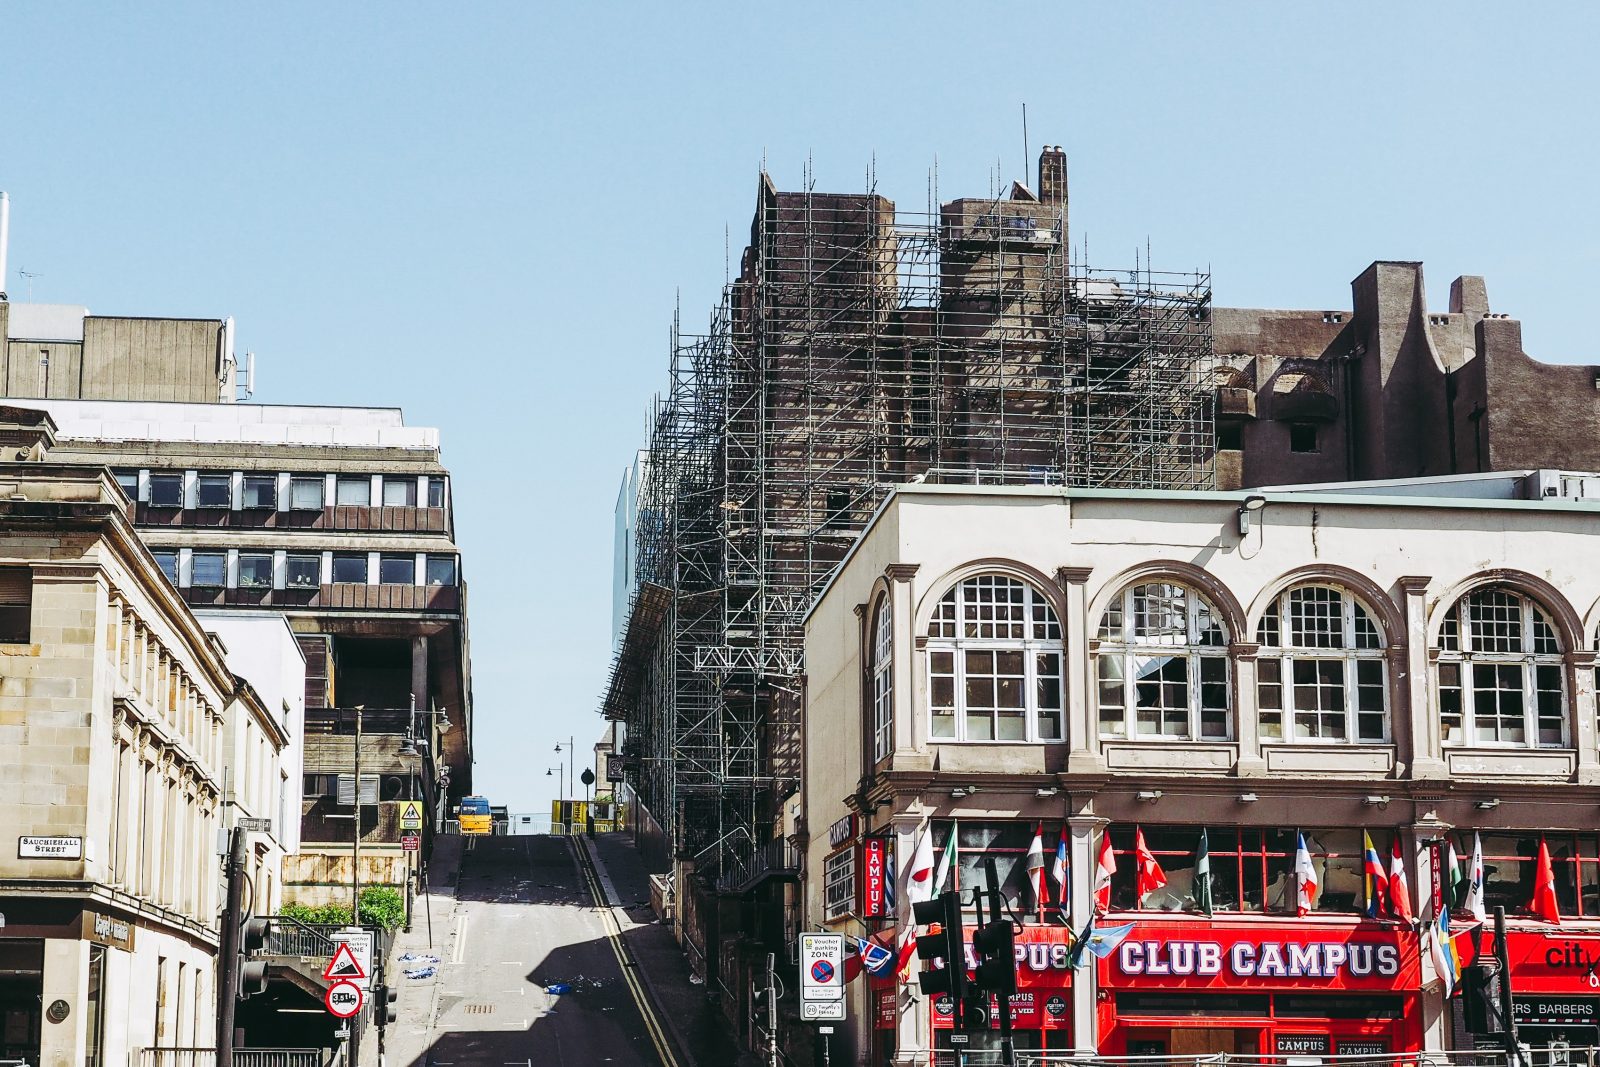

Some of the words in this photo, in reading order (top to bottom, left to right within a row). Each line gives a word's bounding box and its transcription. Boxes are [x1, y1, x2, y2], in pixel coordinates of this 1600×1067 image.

[23, 838, 78, 846] SAUCHIEHALL
[869, 841, 880, 913] CAMPUS
[1432, 846, 1440, 920] CAMPUS
[1120, 941, 1223, 975] CLUB
[1231, 941, 1398, 976] CAMPUS
[1539, 1004, 1593, 1014] BARBERS
[1277, 1041, 1324, 1051] CAMPUS
[1339, 1047, 1382, 1055] CAMPUS
